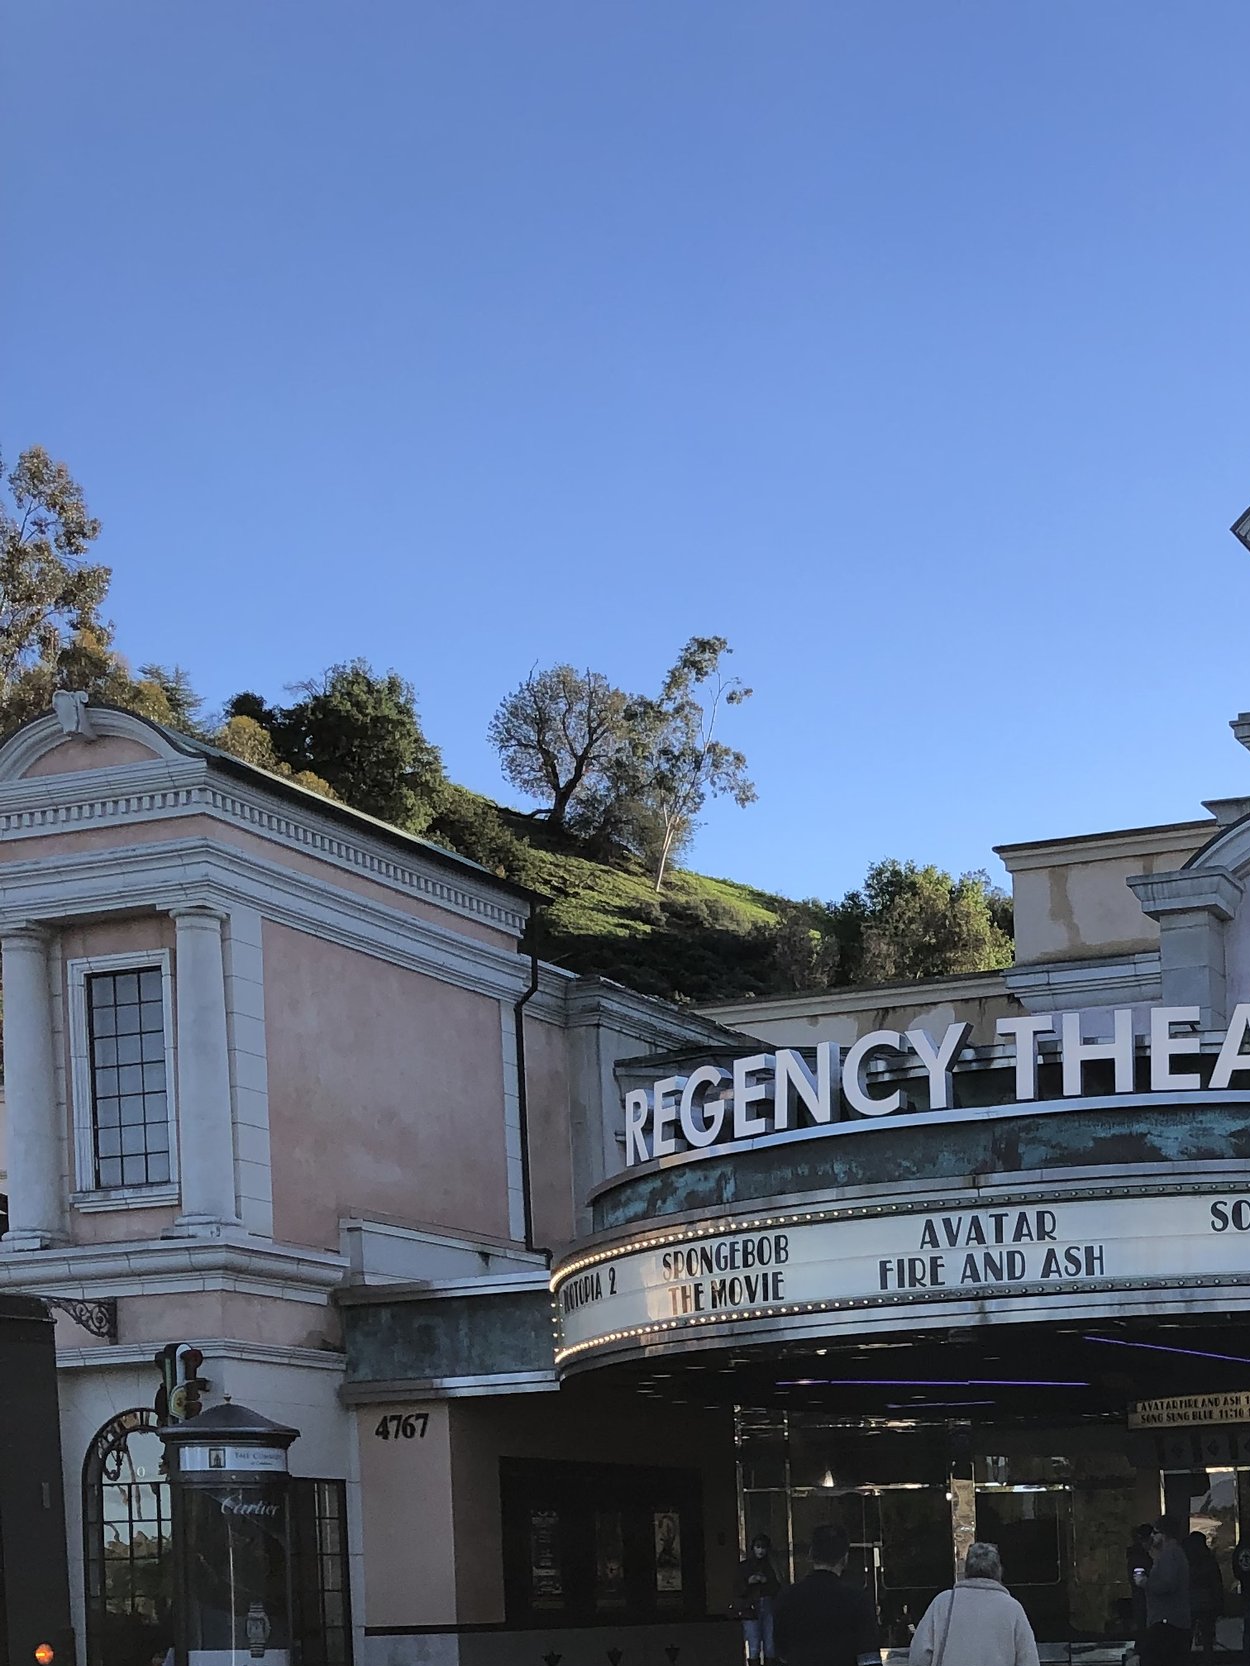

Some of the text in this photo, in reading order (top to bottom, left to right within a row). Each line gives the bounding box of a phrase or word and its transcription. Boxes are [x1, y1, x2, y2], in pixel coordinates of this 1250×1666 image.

[626, 1022, 972, 1167] REGENCY
[919, 1210, 1057, 1250] AVATAR
[662, 1234, 789, 1282] SPONGEBOB
[879, 1245, 1105, 1290] FIRE AND ASH
[608, 1267, 618, 1295] 2
[668, 1271, 785, 1316] THE MOVIE
[1141, 1412, 1164, 1424] SONG
[1166, 1410, 1190, 1422] SUNG
[1192, 1409, 1214, 1421] BLUE
[1219, 1408, 1244, 1419] 11:10
[1223, 1395, 1242, 1406] ASH
[375, 1413, 430, 1440] 4767
